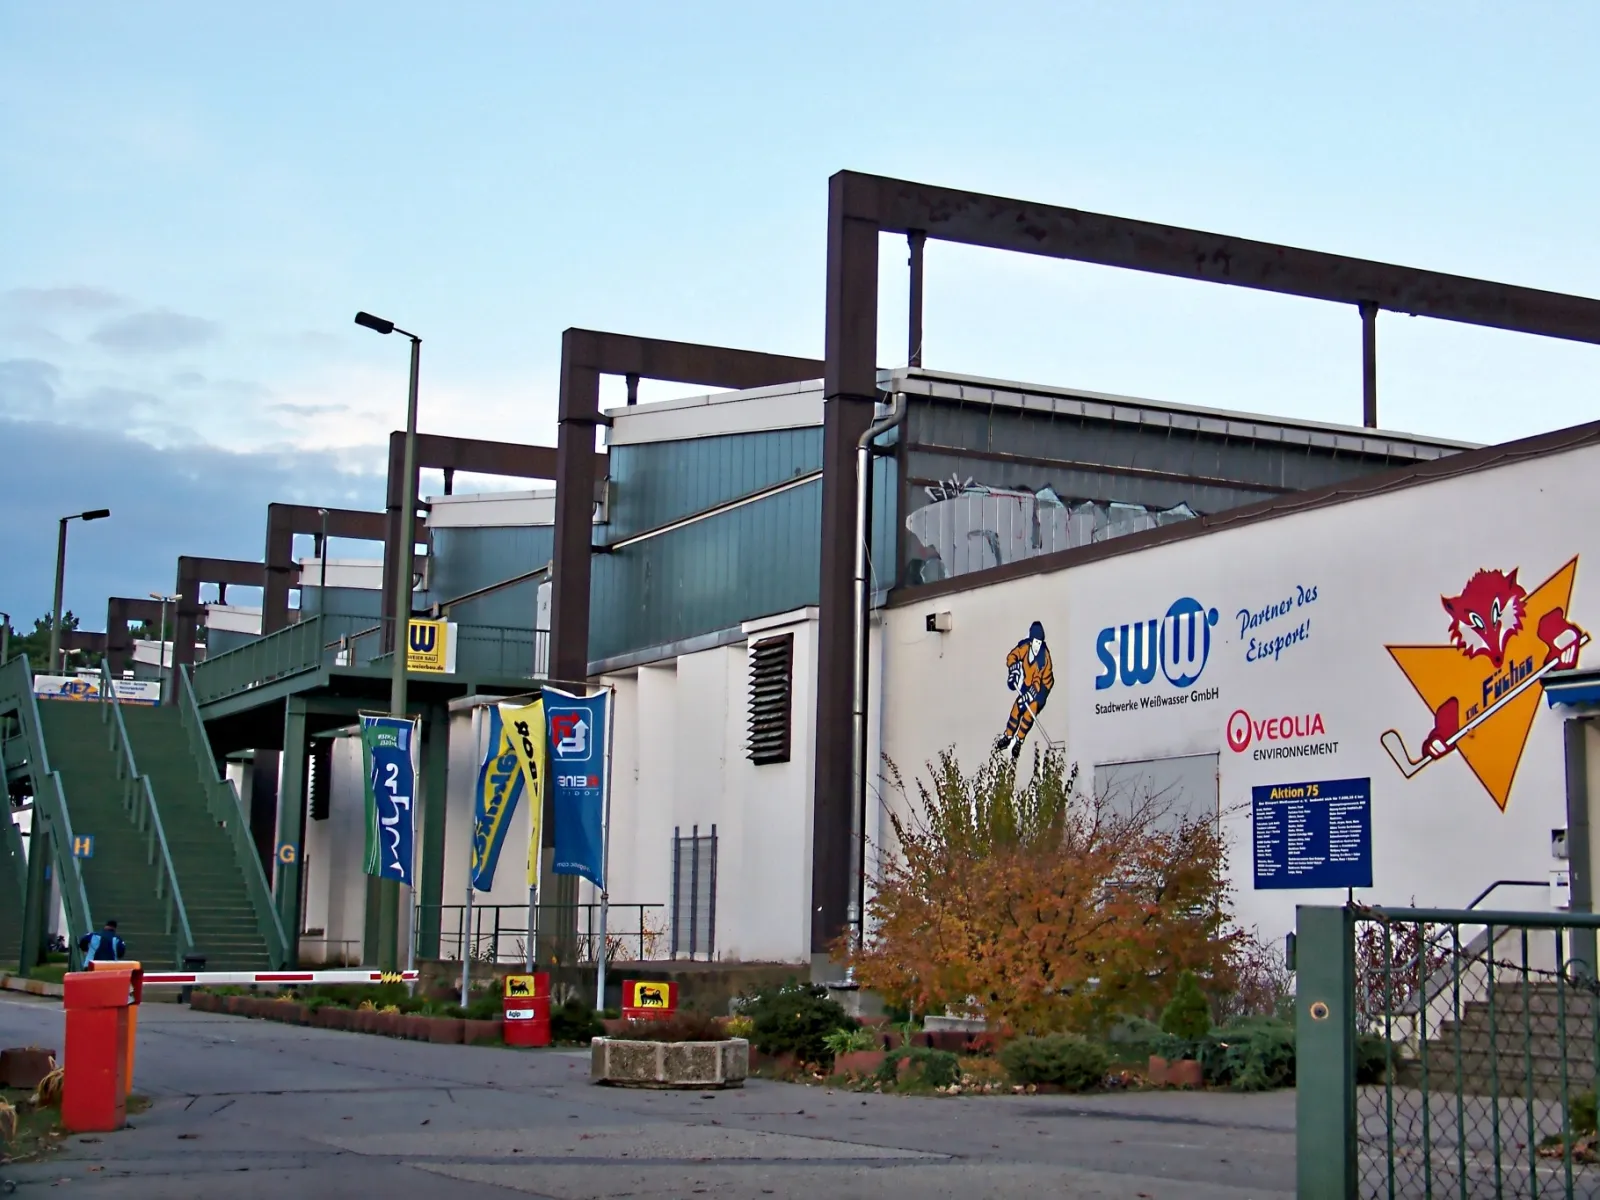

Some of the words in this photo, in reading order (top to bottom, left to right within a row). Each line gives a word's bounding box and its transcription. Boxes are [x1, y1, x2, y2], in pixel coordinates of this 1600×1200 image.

[1236, 596, 1294, 640] Partner
[1296, 584, 1319, 608] des
[410, 624, 436, 653] W
[1245, 618, 1311, 662] Eissport!
[1095, 694, 1139, 715] Stadtwerke
[1139, 692, 1190, 710] Weißwasser
[1190, 687, 1220, 704] GmbH
[1253, 713, 1326, 742] VEOLIA
[1253, 741, 1340, 761] ENVIRONNEMENT
[1270, 787, 1304, 800] Aktion
[1306, 784, 1319, 797] 75
[74, 837, 91, 856] H
[280, 844, 296, 862] G
